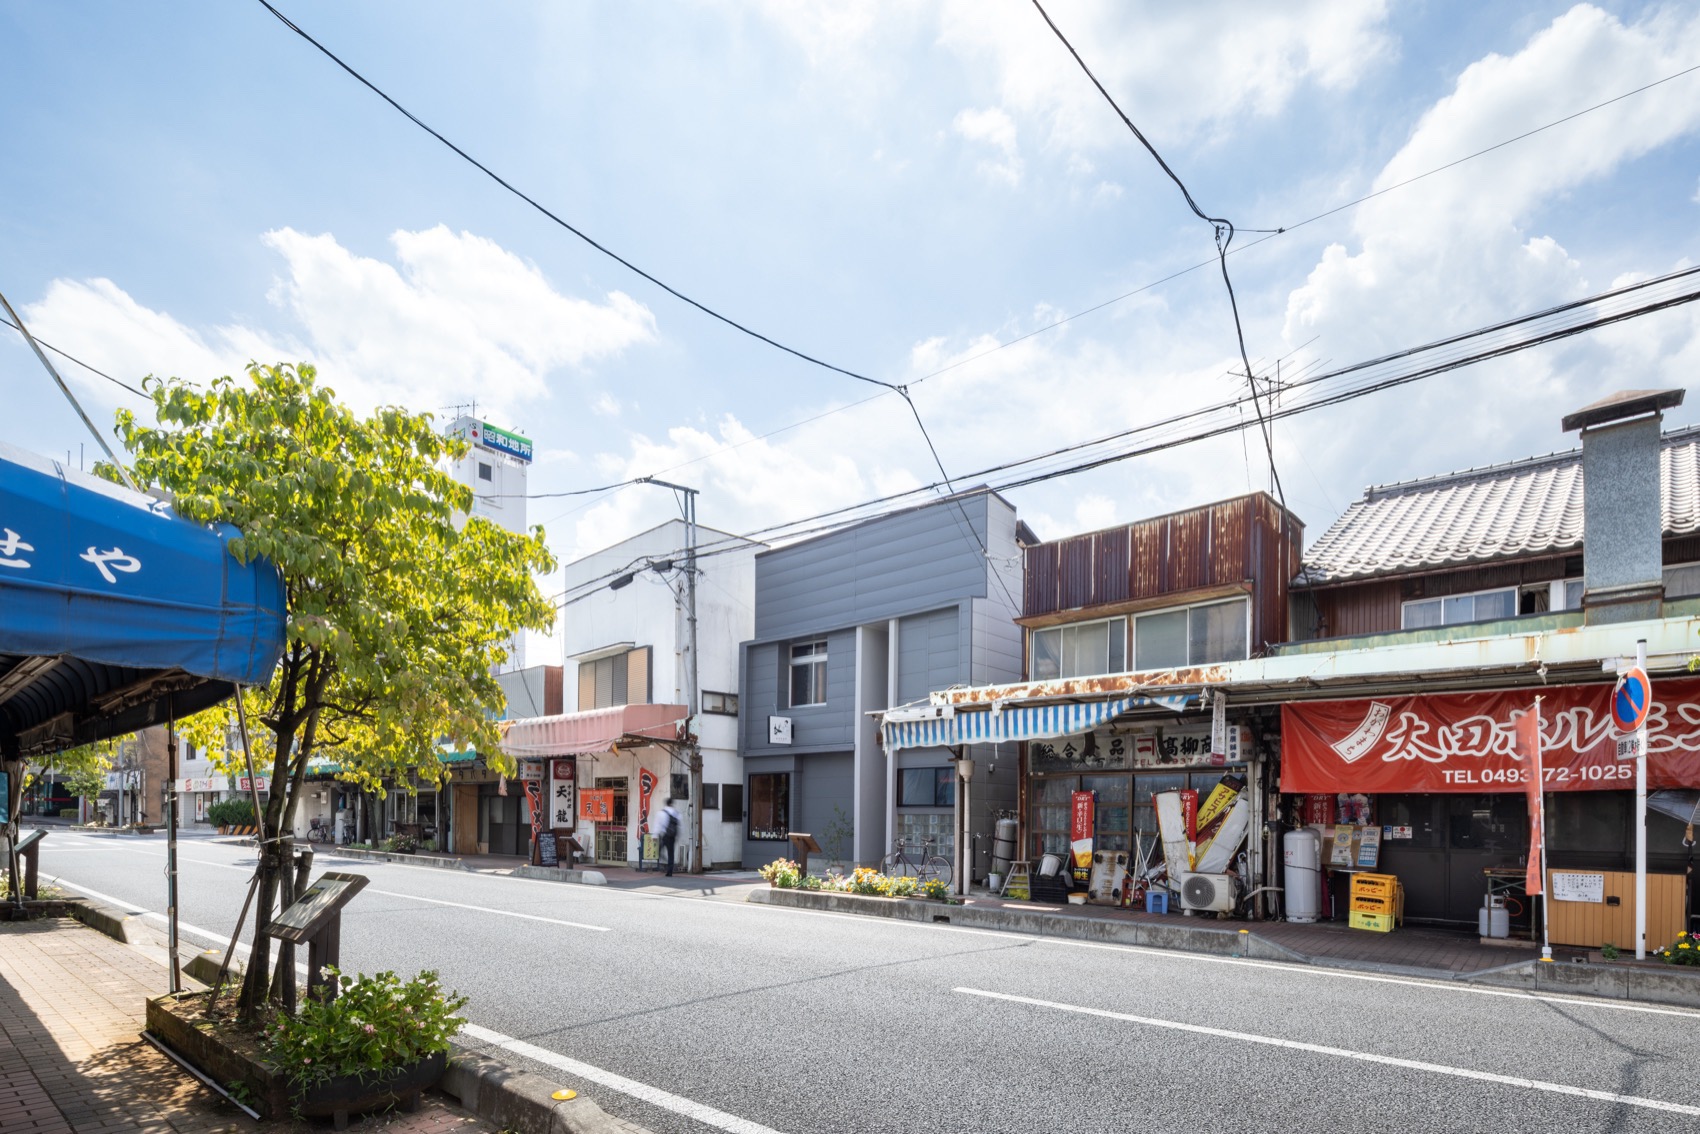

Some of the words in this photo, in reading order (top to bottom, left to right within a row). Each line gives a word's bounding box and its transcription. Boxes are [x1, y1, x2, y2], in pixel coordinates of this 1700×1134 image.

[483, 429, 531, 456] 昭和地所
[1041, 739, 1124, 759] 総合品
[1442, 770, 1478, 784] TEL
[1481, 765, 1632, 783] 049372-1025
[556, 785, 568, 823] 天龍
